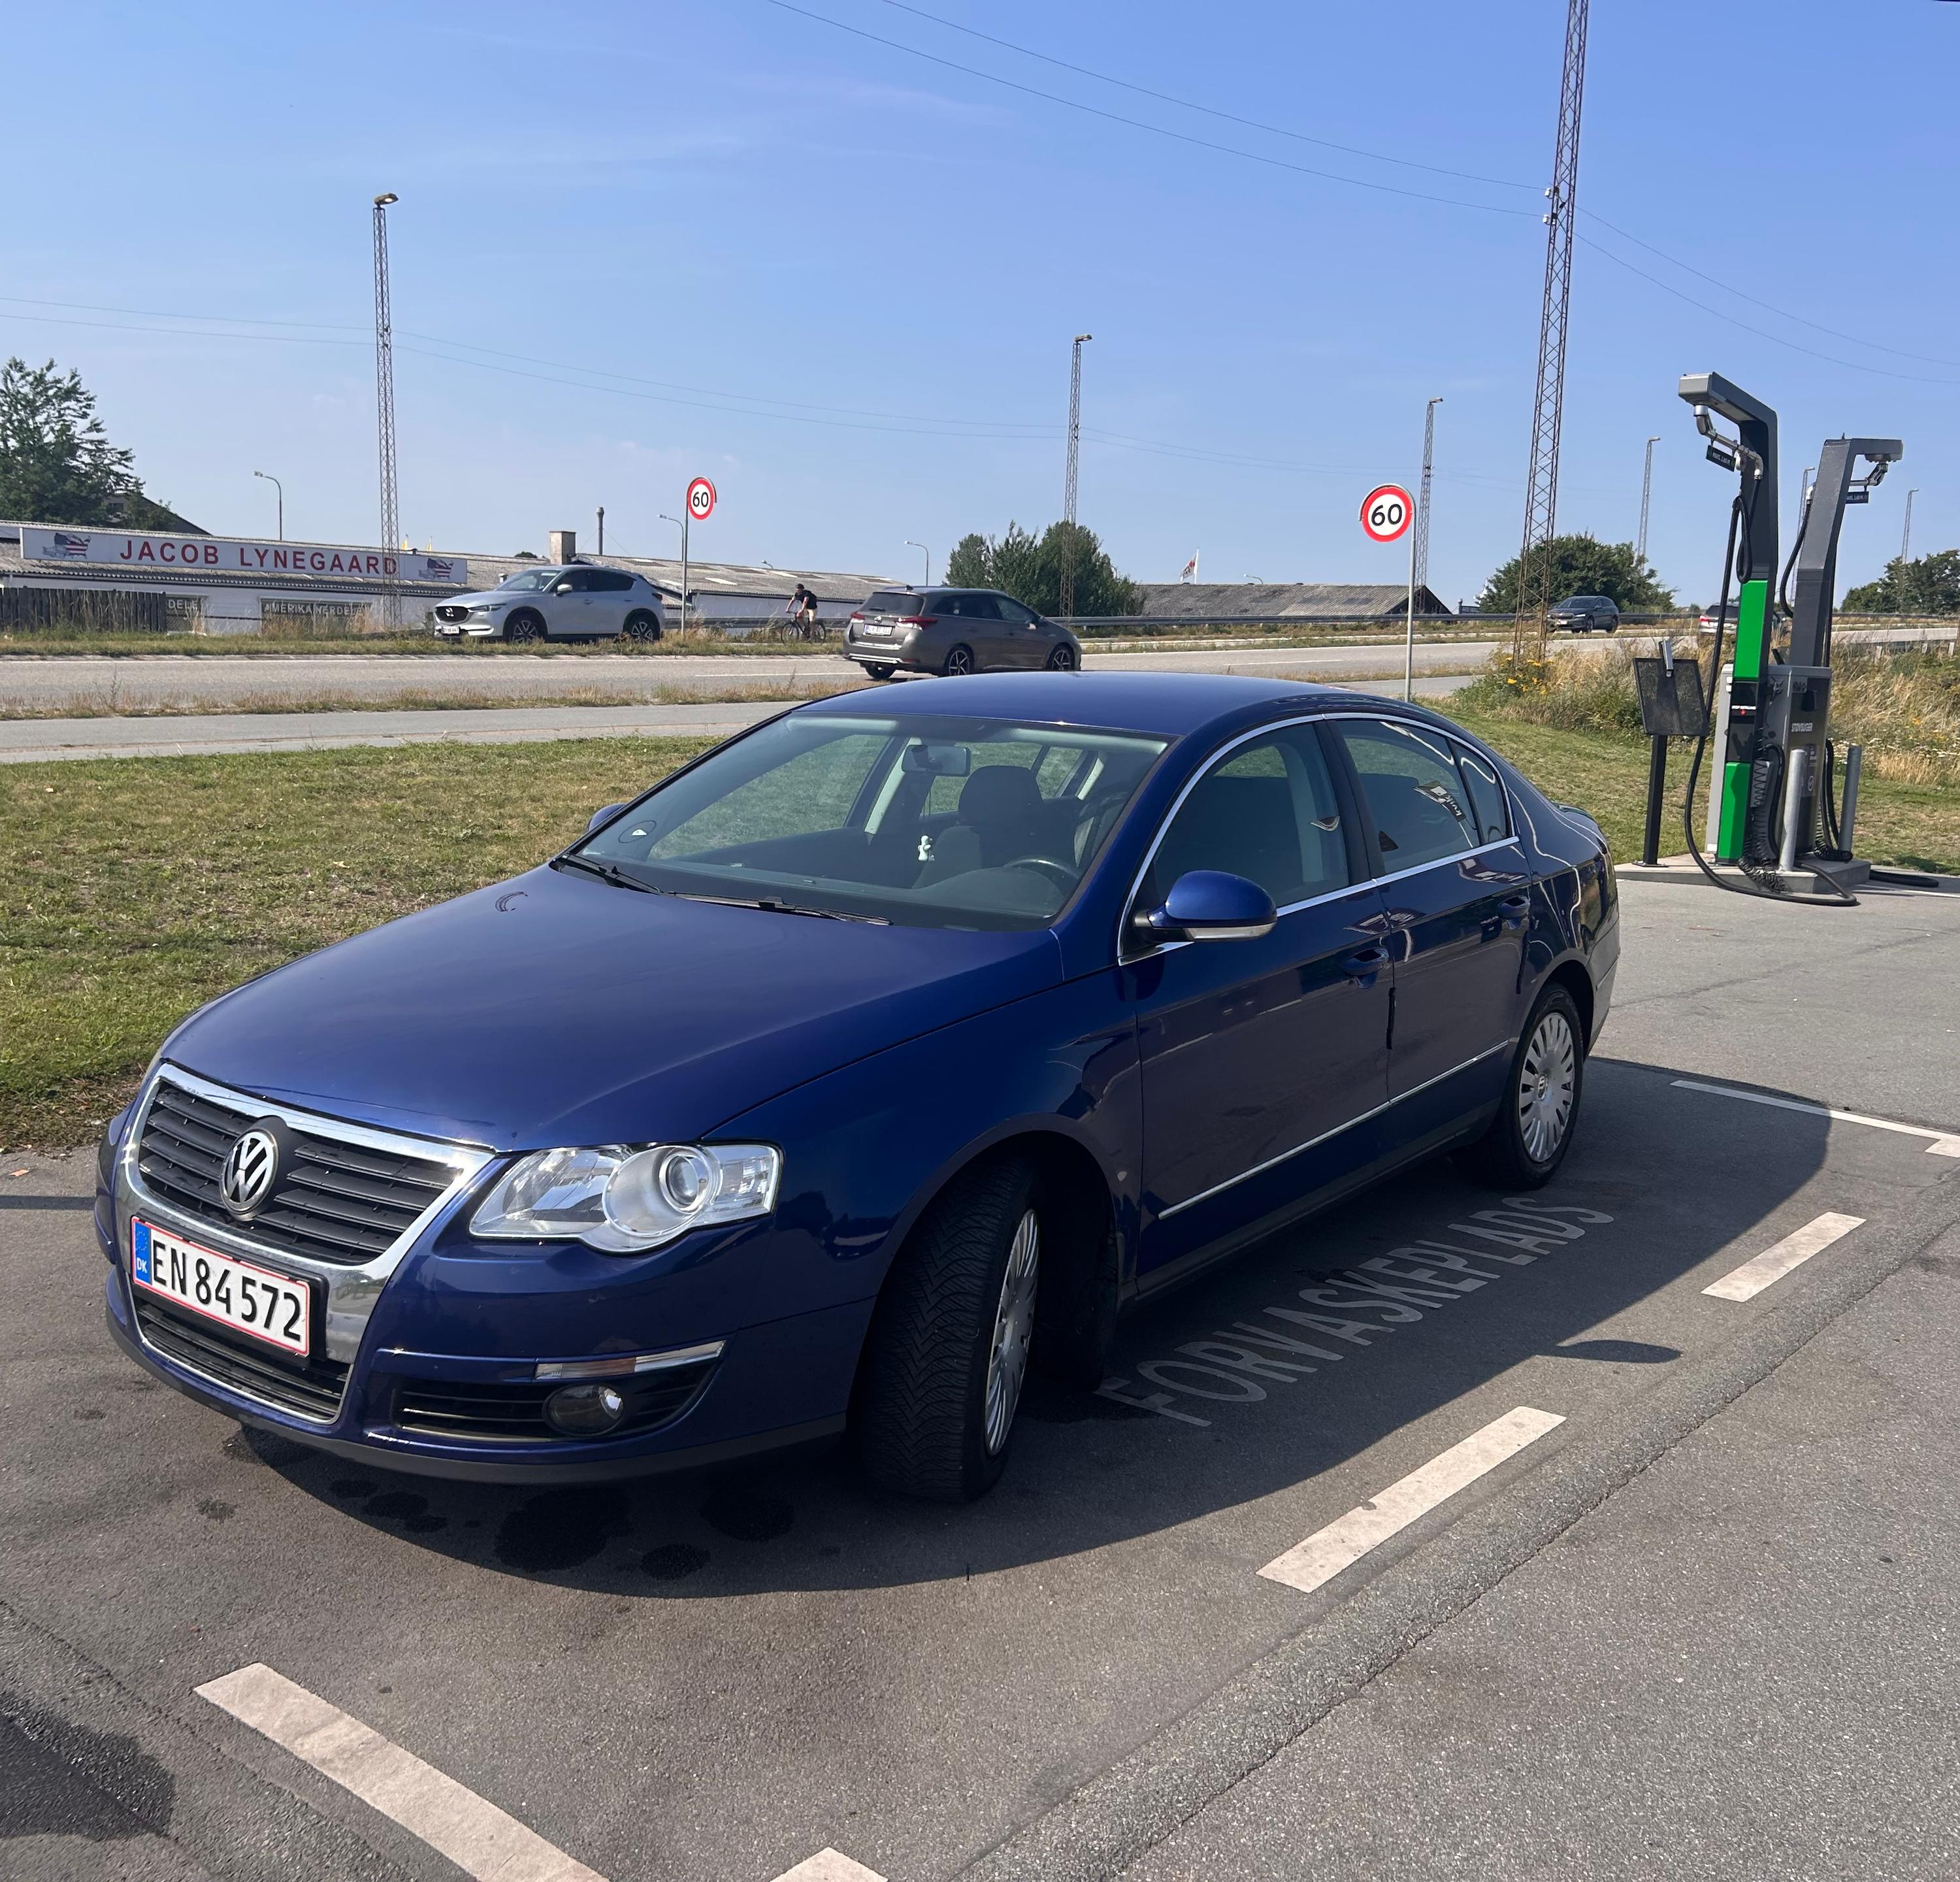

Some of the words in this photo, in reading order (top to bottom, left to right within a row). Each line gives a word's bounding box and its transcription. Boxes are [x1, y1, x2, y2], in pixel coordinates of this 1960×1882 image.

[693, 491, 709, 508] 60
[1371, 504, 1402, 526] 60
[120, 540, 219, 565] JACOB
[240, 548, 397, 575] LYNEGAARD
[136, 1257, 148, 1274] DK
[153, 1239, 188, 1296] EN
[195, 1258, 231, 1315] 84
[241, 1275, 301, 1342] 572
[1094, 1197, 1614, 1427] FORVASKEPLADS
